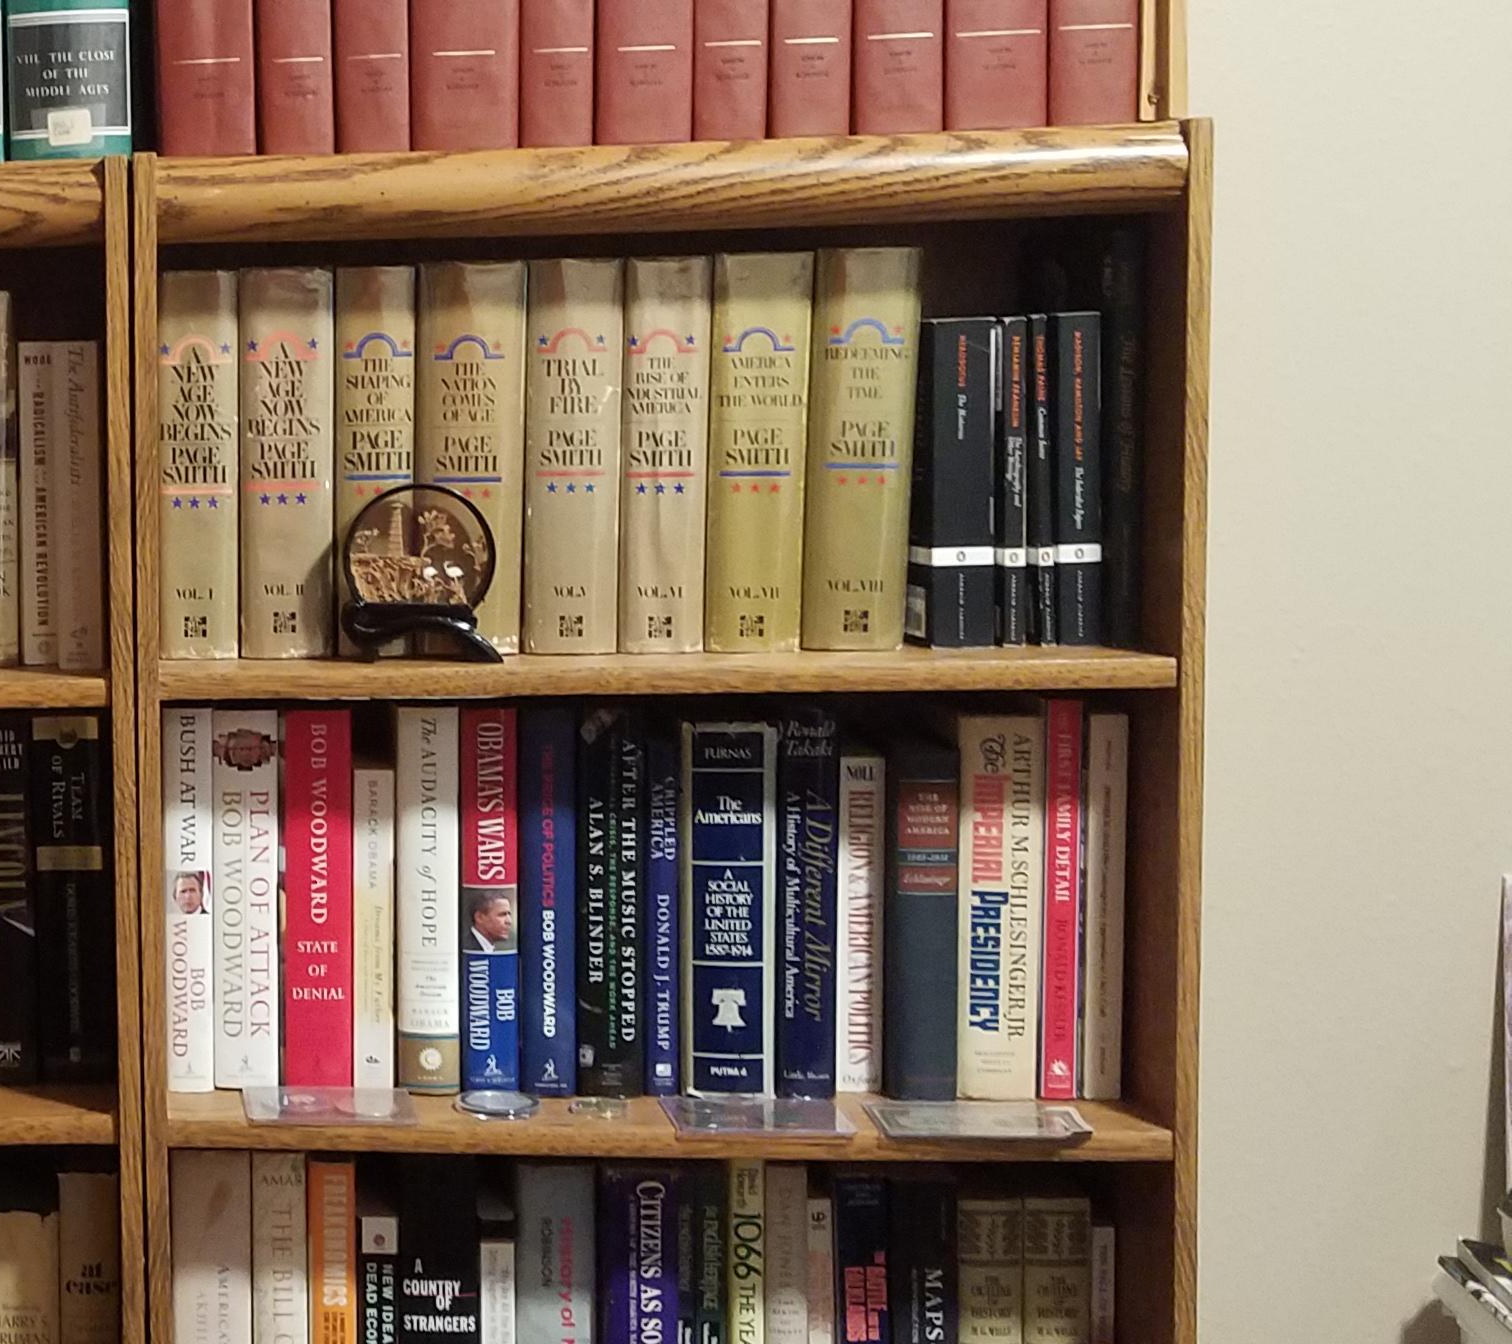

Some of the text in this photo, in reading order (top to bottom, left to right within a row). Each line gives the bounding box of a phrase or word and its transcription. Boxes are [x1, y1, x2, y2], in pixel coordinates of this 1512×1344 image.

[179, 714, 197, 865] BUSH AT WAR
[420, 746, 437, 858] AUDACITY
[694, 810, 761, 825] Americans
[309, 777, 328, 926] WOODWARD
[475, 816, 506, 883] WARS
[250, 790, 271, 1039] PLAN OF ATTACK
[422, 889, 438, 947] HOPE
[705, 892, 753, 906] HISTORY
[297, 940, 339, 954] STATE
[588, 888, 604, 985] BLINDER
[622, 866, 635, 1043] MUSIC STOPPED
[655, 893, 671, 1051] DONALD TRUMP
[171, 919, 189, 1058] WOODWARD
[292, 986, 345, 1002] DENIAL
[541, 909, 556, 1039] BOB WOODWARD
[636, 1180, 666, 1280] CITIZENS
[733, 1212, 762, 1279] 1066
[403, 1280, 461, 1296] COUNTRY
[404, 1315, 476, 1333] STRANGERS
[640, 1285, 663, 1307] AS
[924, 1267, 944, 1340] MAPS
